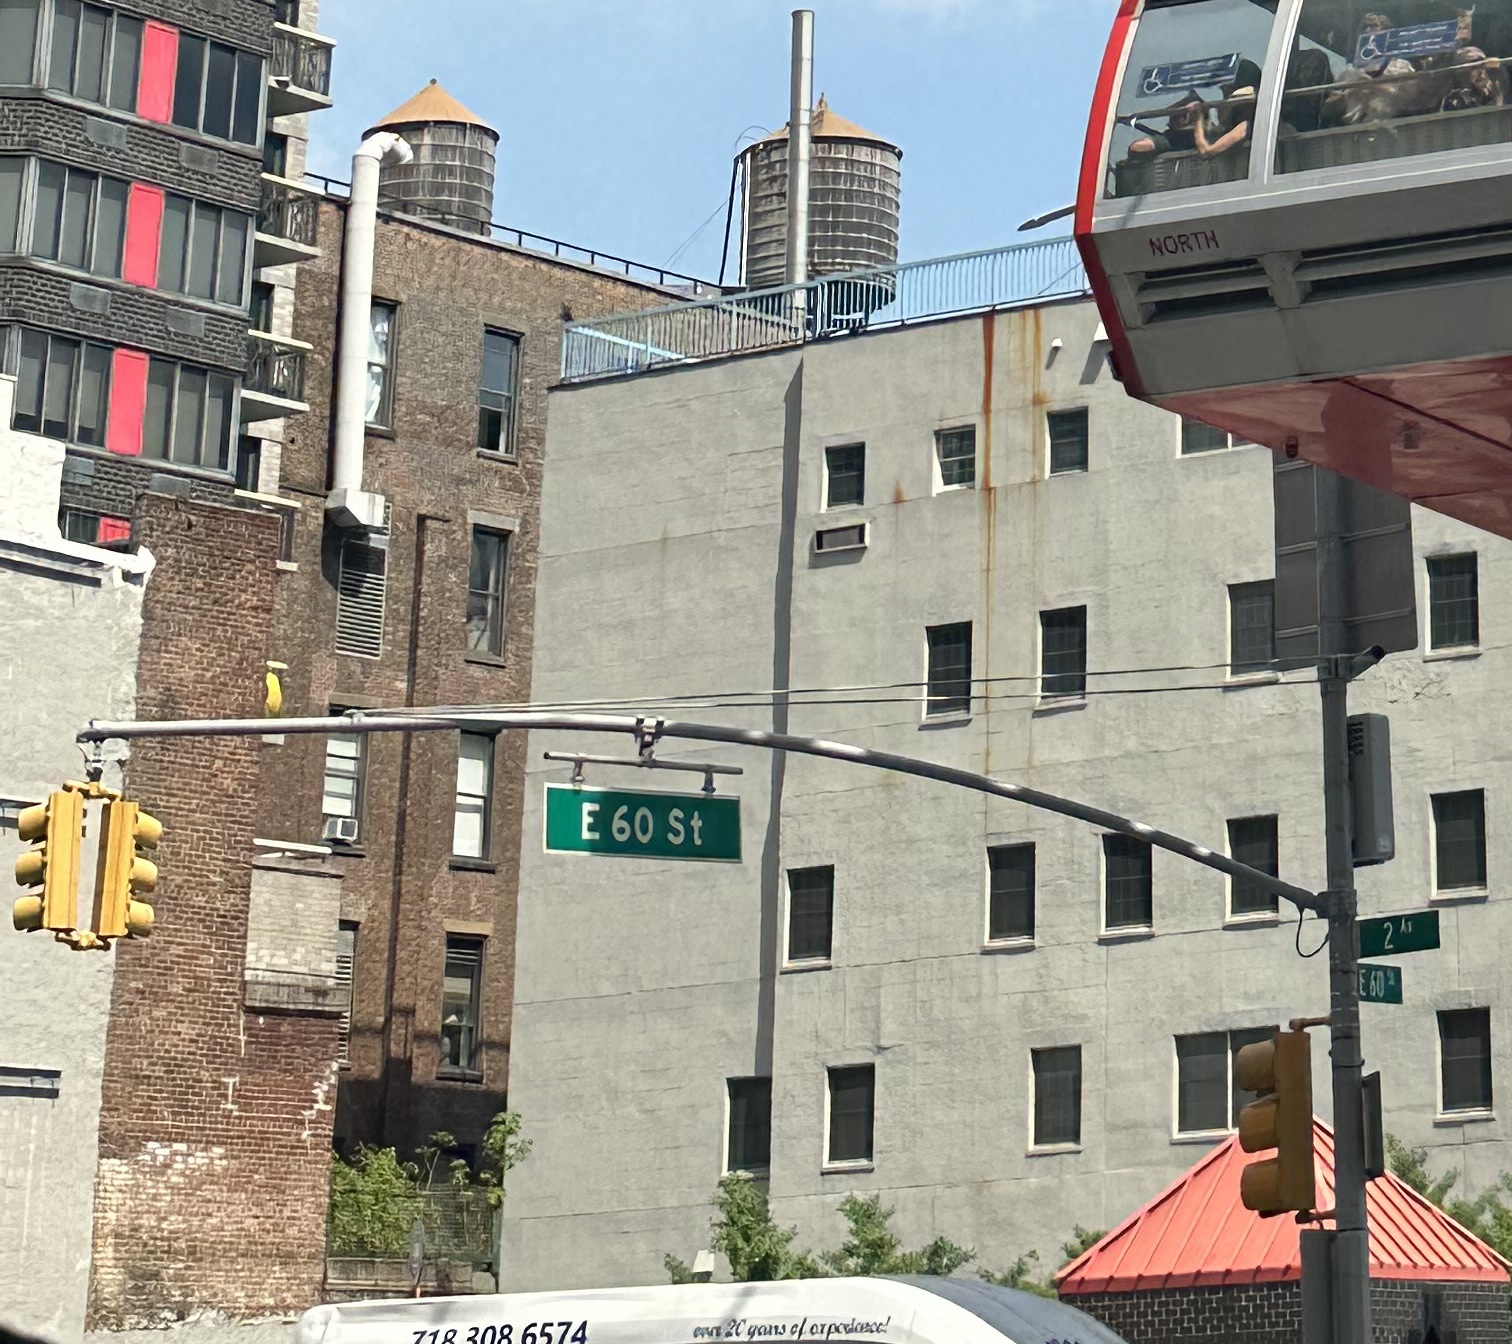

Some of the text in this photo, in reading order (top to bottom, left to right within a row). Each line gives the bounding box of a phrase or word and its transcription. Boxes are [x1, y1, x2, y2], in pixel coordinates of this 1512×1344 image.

[1148, 229, 1219, 256] NORTH
[580, 802, 703, 846] E 60 St
[1383, 921, 1395, 950] 2
[1359, 969, 1366, 996] E
[1369, 970, 1385, 998] 60
[411, 1319, 588, 1344] 718 308 6574
[790, 1316, 808, 1340] of
